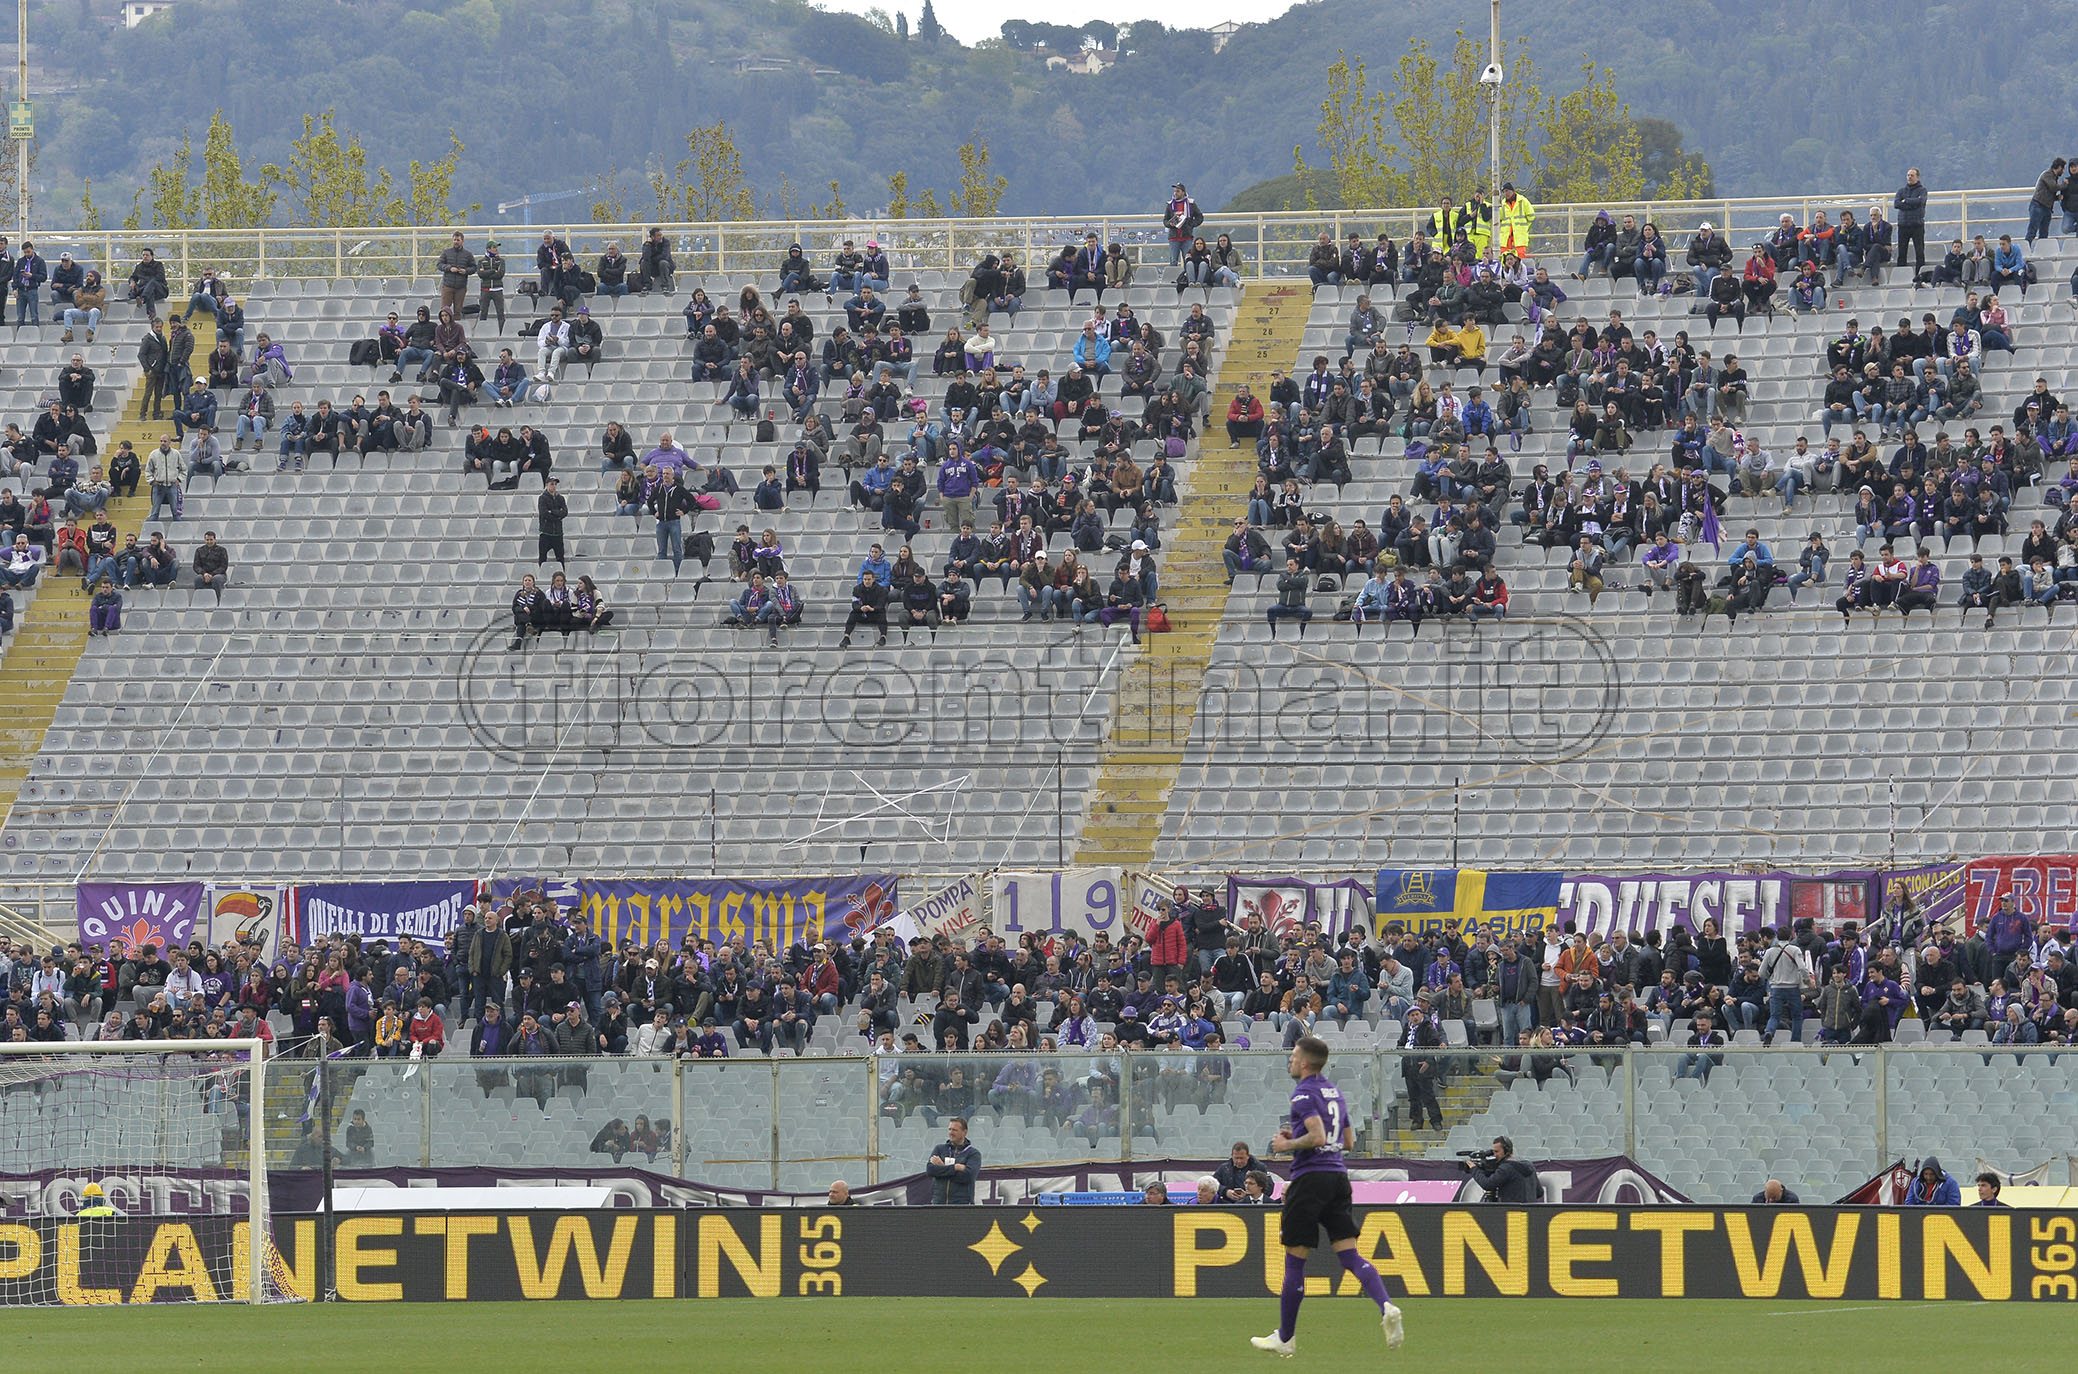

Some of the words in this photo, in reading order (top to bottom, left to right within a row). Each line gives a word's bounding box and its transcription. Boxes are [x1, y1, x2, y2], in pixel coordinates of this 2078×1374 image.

[1269, 307, 1279, 315] 27
[192, 322, 202, 330] 27
[1262, 328, 1273, 336] 26
[1256, 350, 1268, 358] 25
[142, 432, 152, 440] 22
[1171, 646, 1181, 654] 12
[913, 879, 974, 927] POMPA
[2011, 867, 2078, 927] BE
[308, 898, 364, 946] QUELLI
[370, 913, 390, 934] DI
[395, 892, 462, 938] SEMPRE
[935, 907, 977, 938] VIVE
[1488, 912, 1545, 936] SUD
[1326, 1101, 1340, 1144] 3
[799, 1214, 842, 1297] 365
[1174, 1211, 2012, 1301] PLANETWIN
[2030, 1215, 2077, 1300] 365
